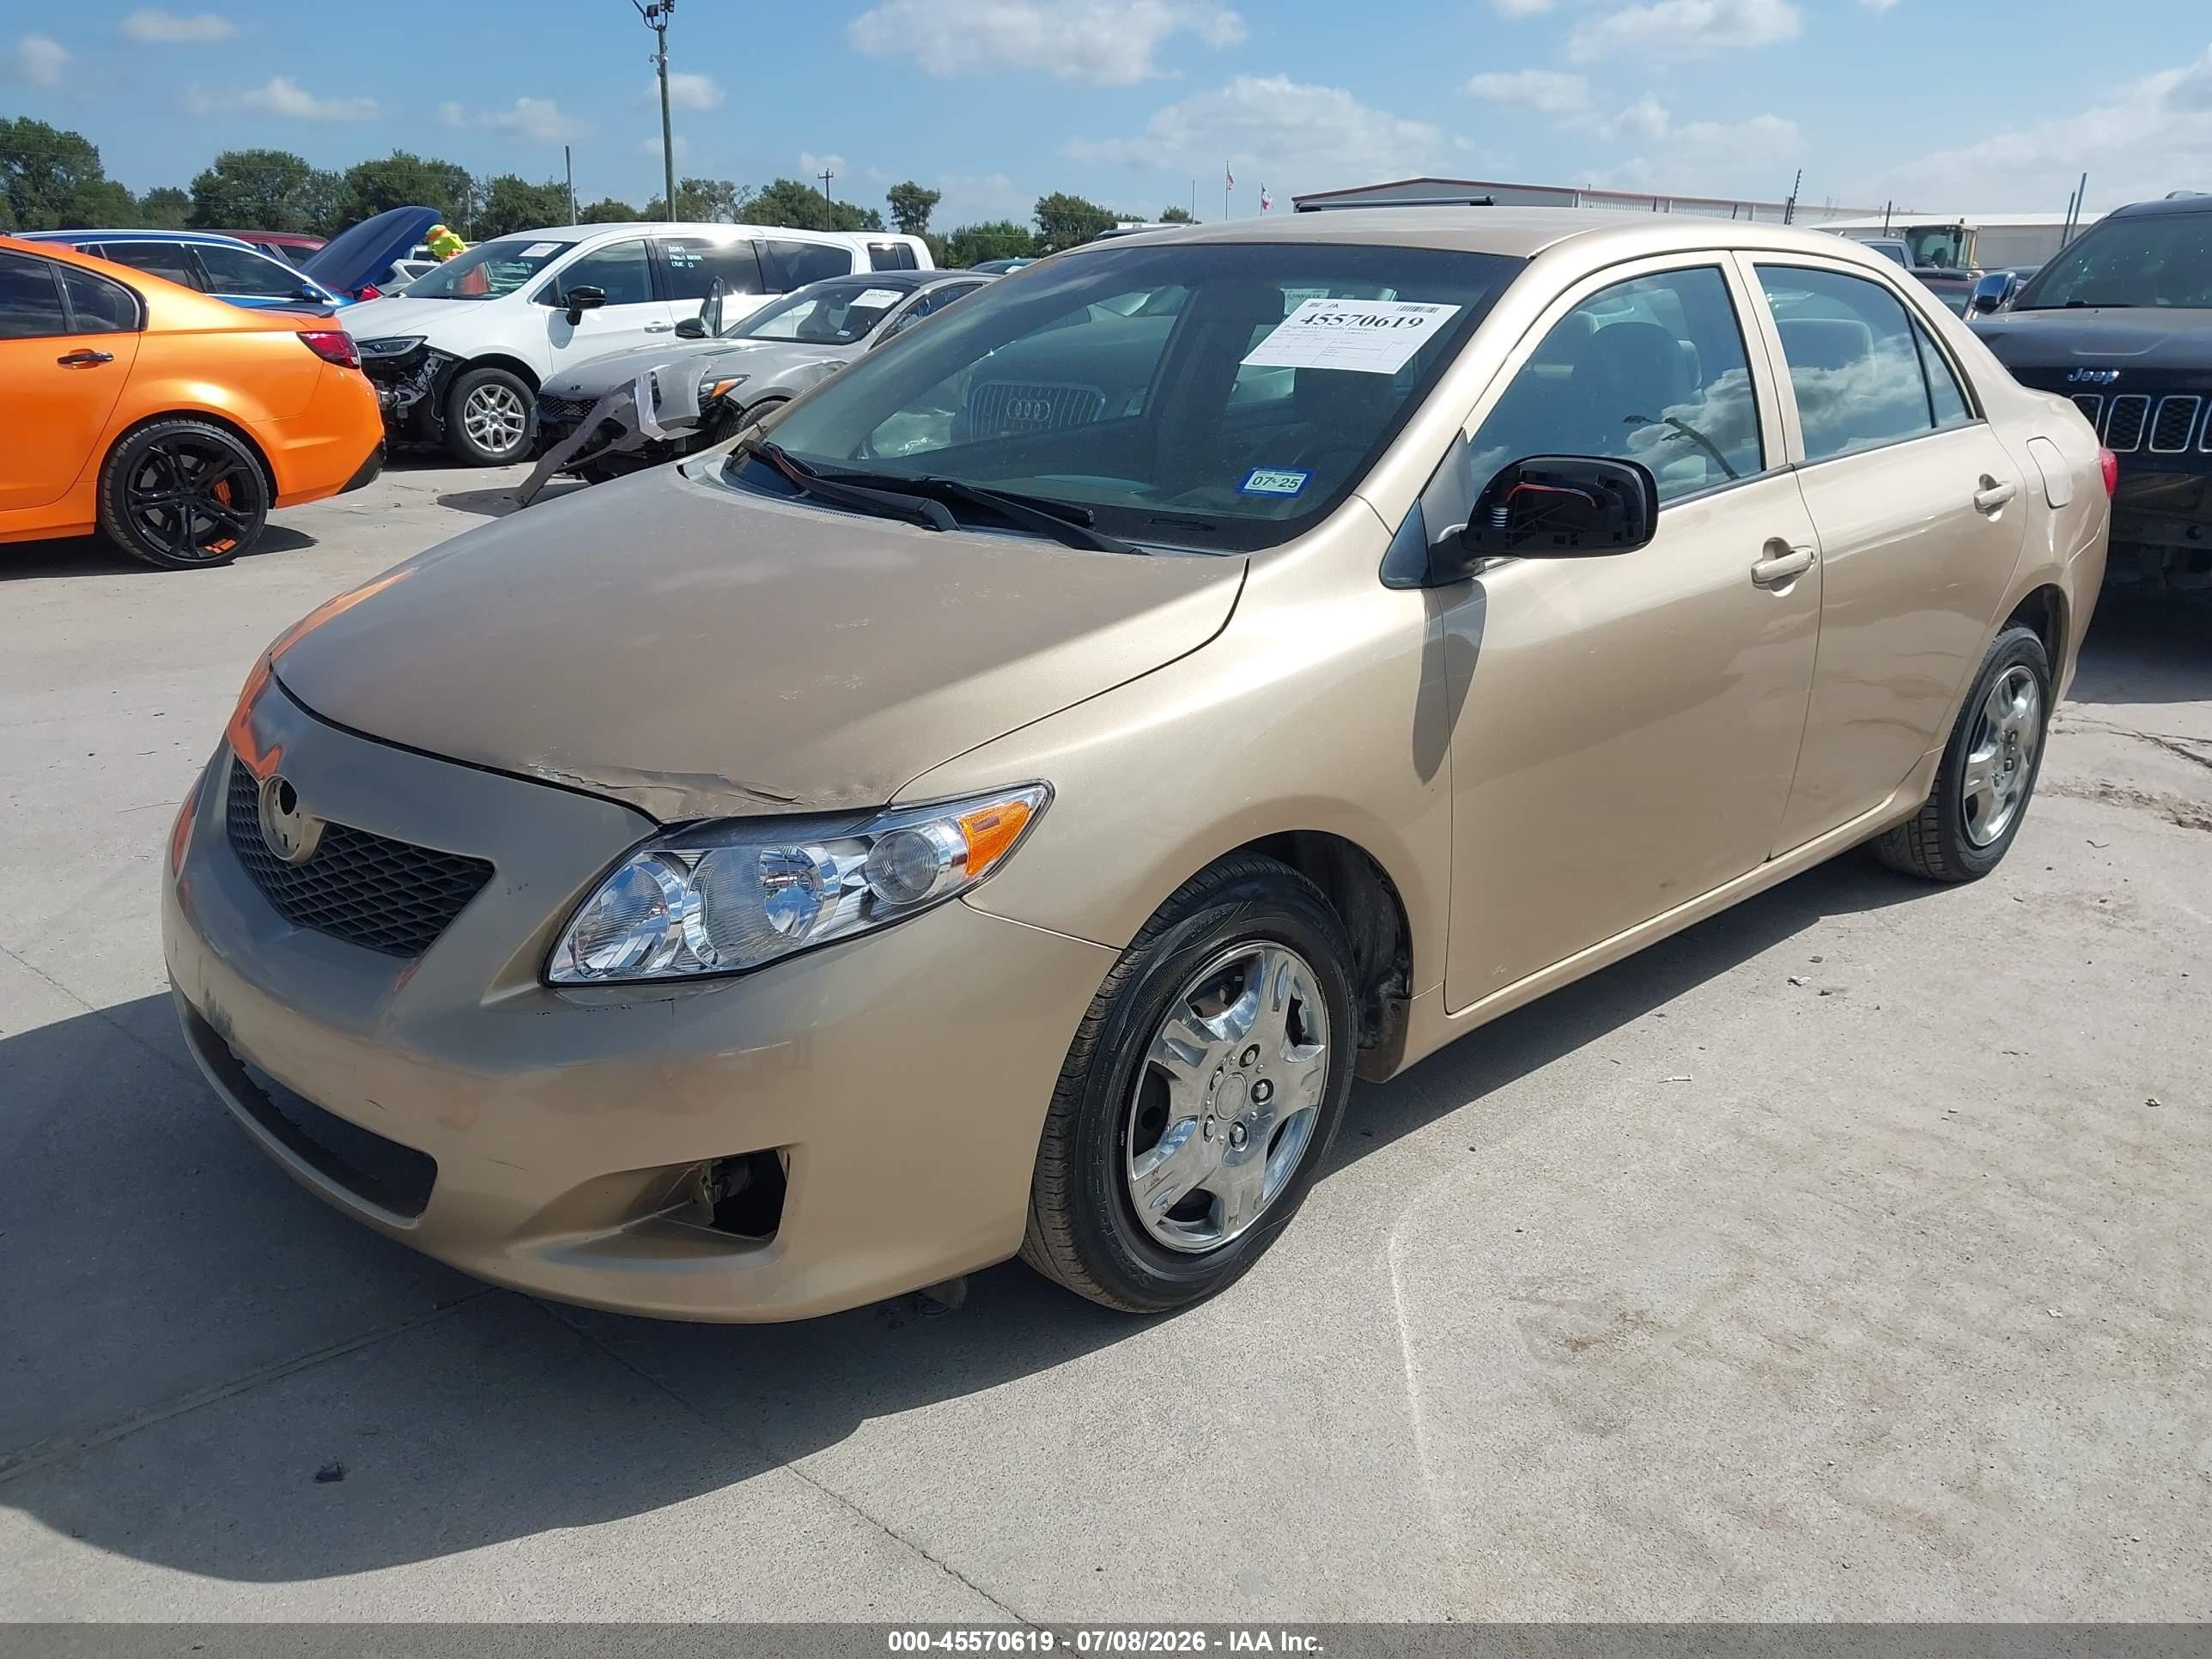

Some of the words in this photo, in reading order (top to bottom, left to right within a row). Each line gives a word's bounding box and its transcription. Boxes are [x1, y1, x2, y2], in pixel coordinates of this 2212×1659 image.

[1300, 313, 1424, 329] 45570619
[2067, 368, 2120, 386] Jeep
[1252, 476, 1273, 486] 07
[1277, 477, 1301, 489] 25
